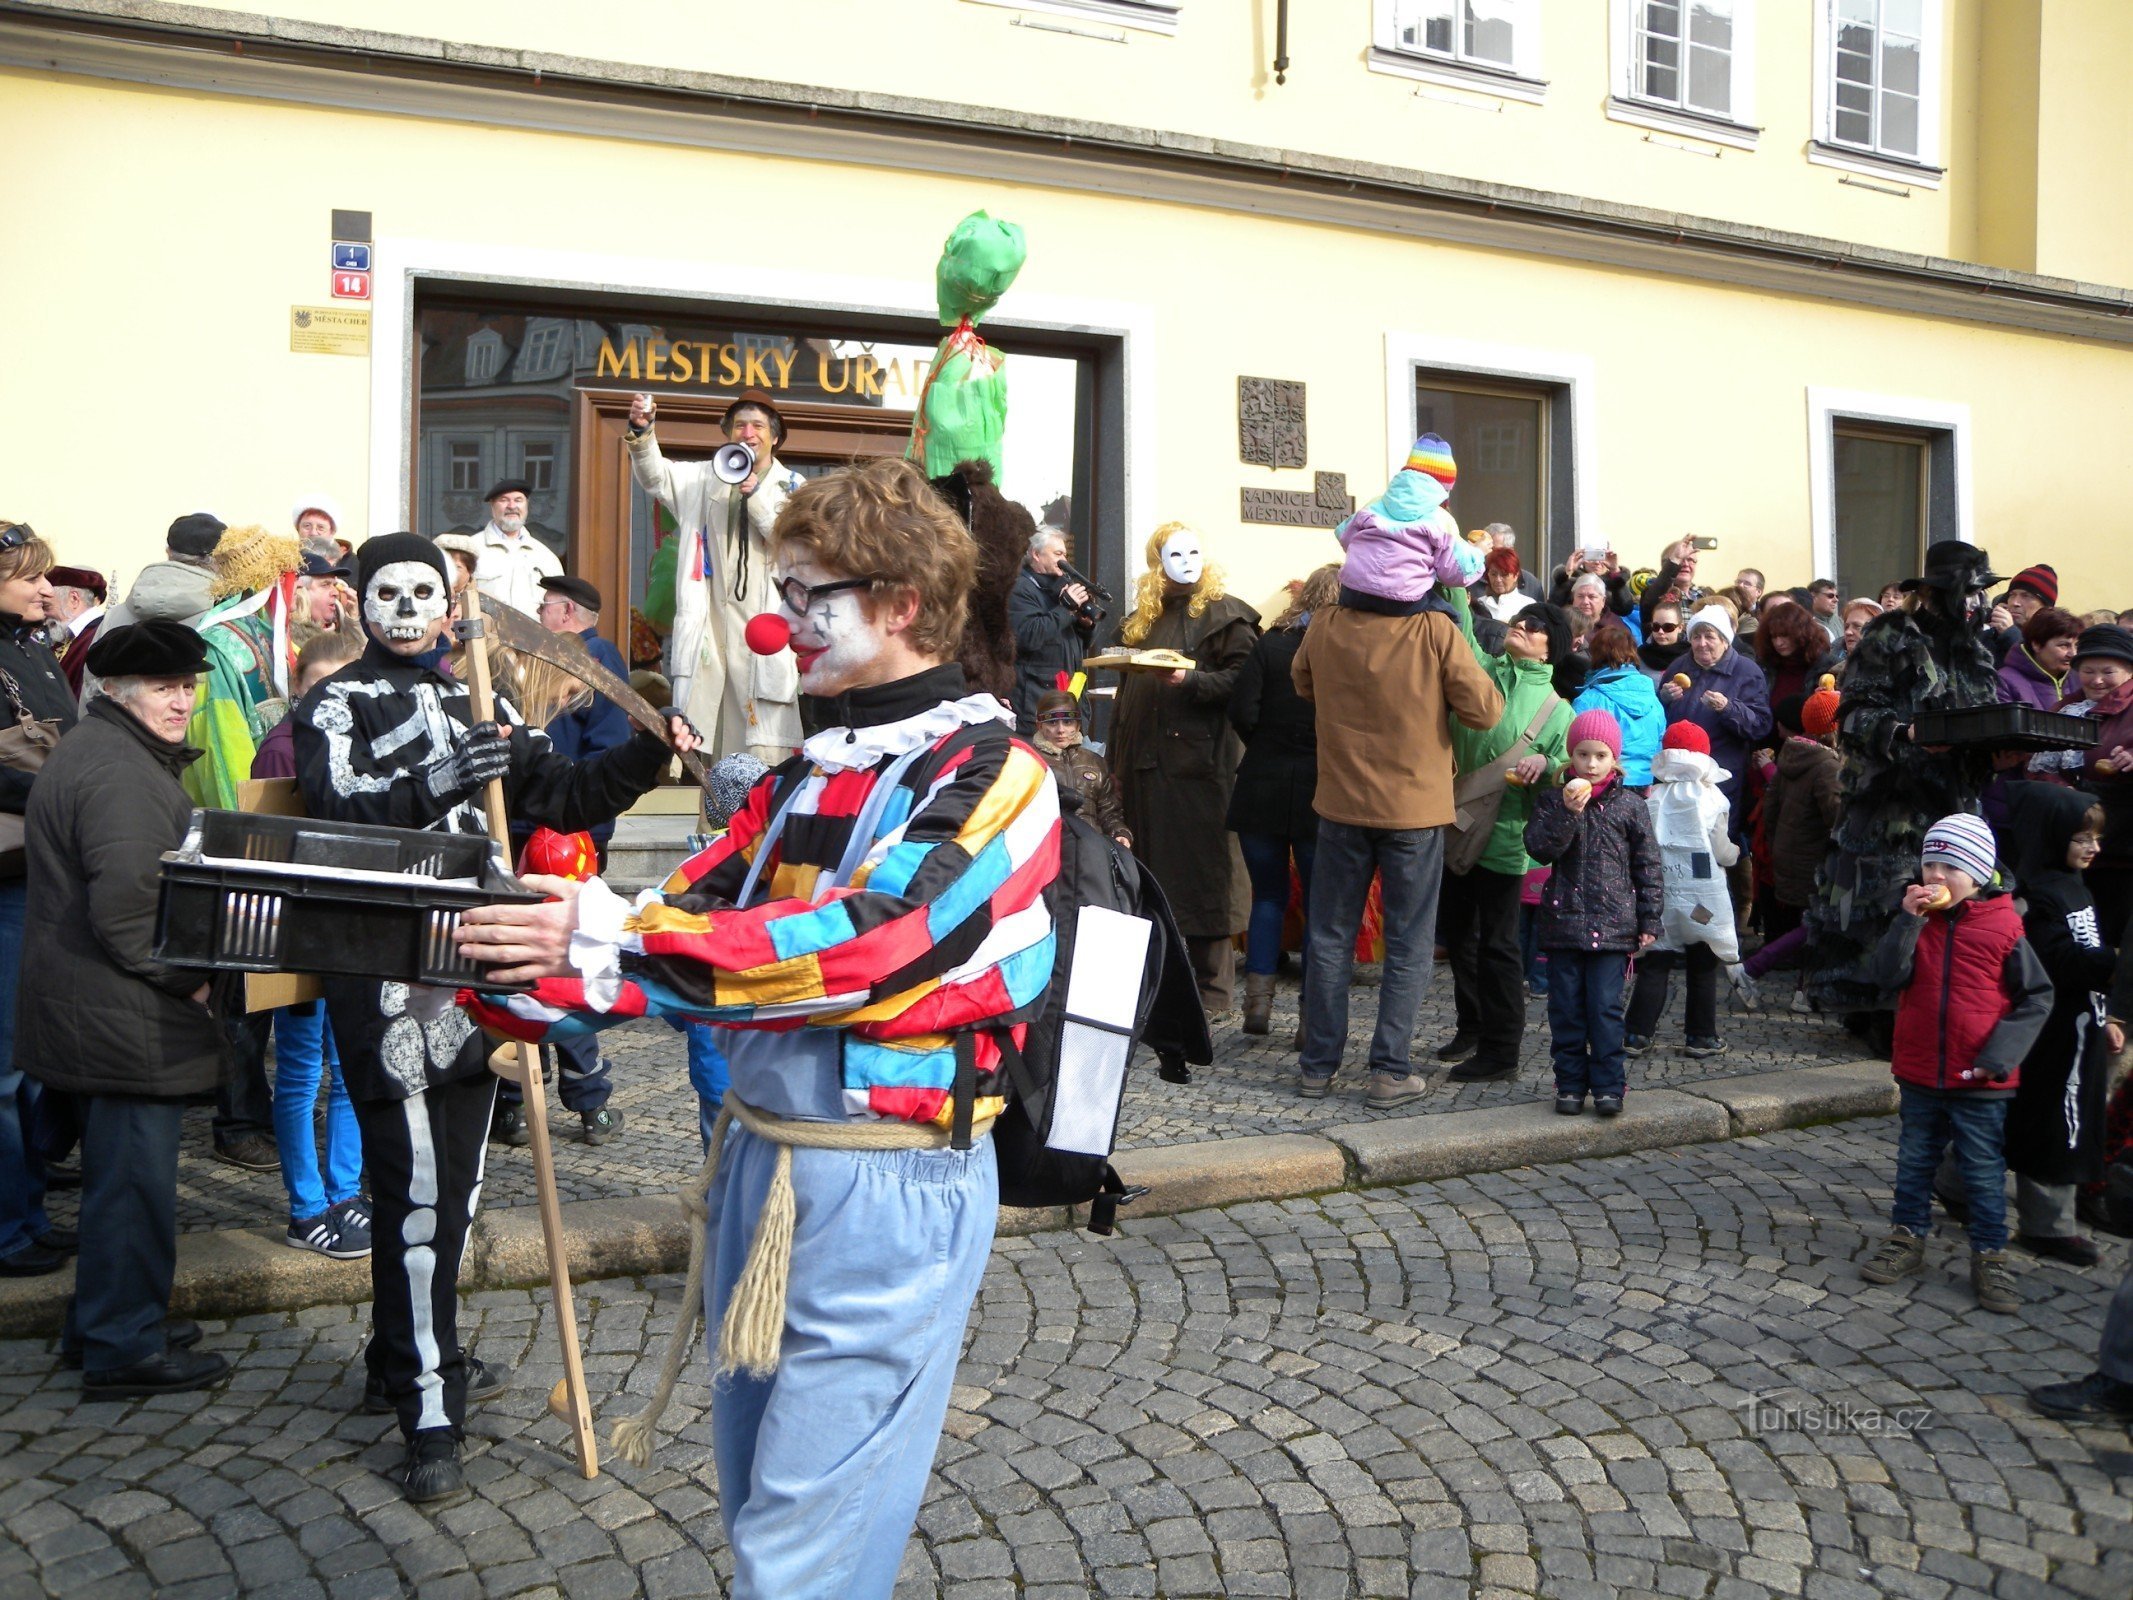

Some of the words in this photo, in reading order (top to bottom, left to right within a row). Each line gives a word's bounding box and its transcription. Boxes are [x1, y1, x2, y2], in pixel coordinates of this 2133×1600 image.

[349, 247, 355, 259] 1
[342, 277, 361, 293] 14
[314, 316, 342, 324] MĚSTA
[1243, 490, 1310, 507] RADNICE
